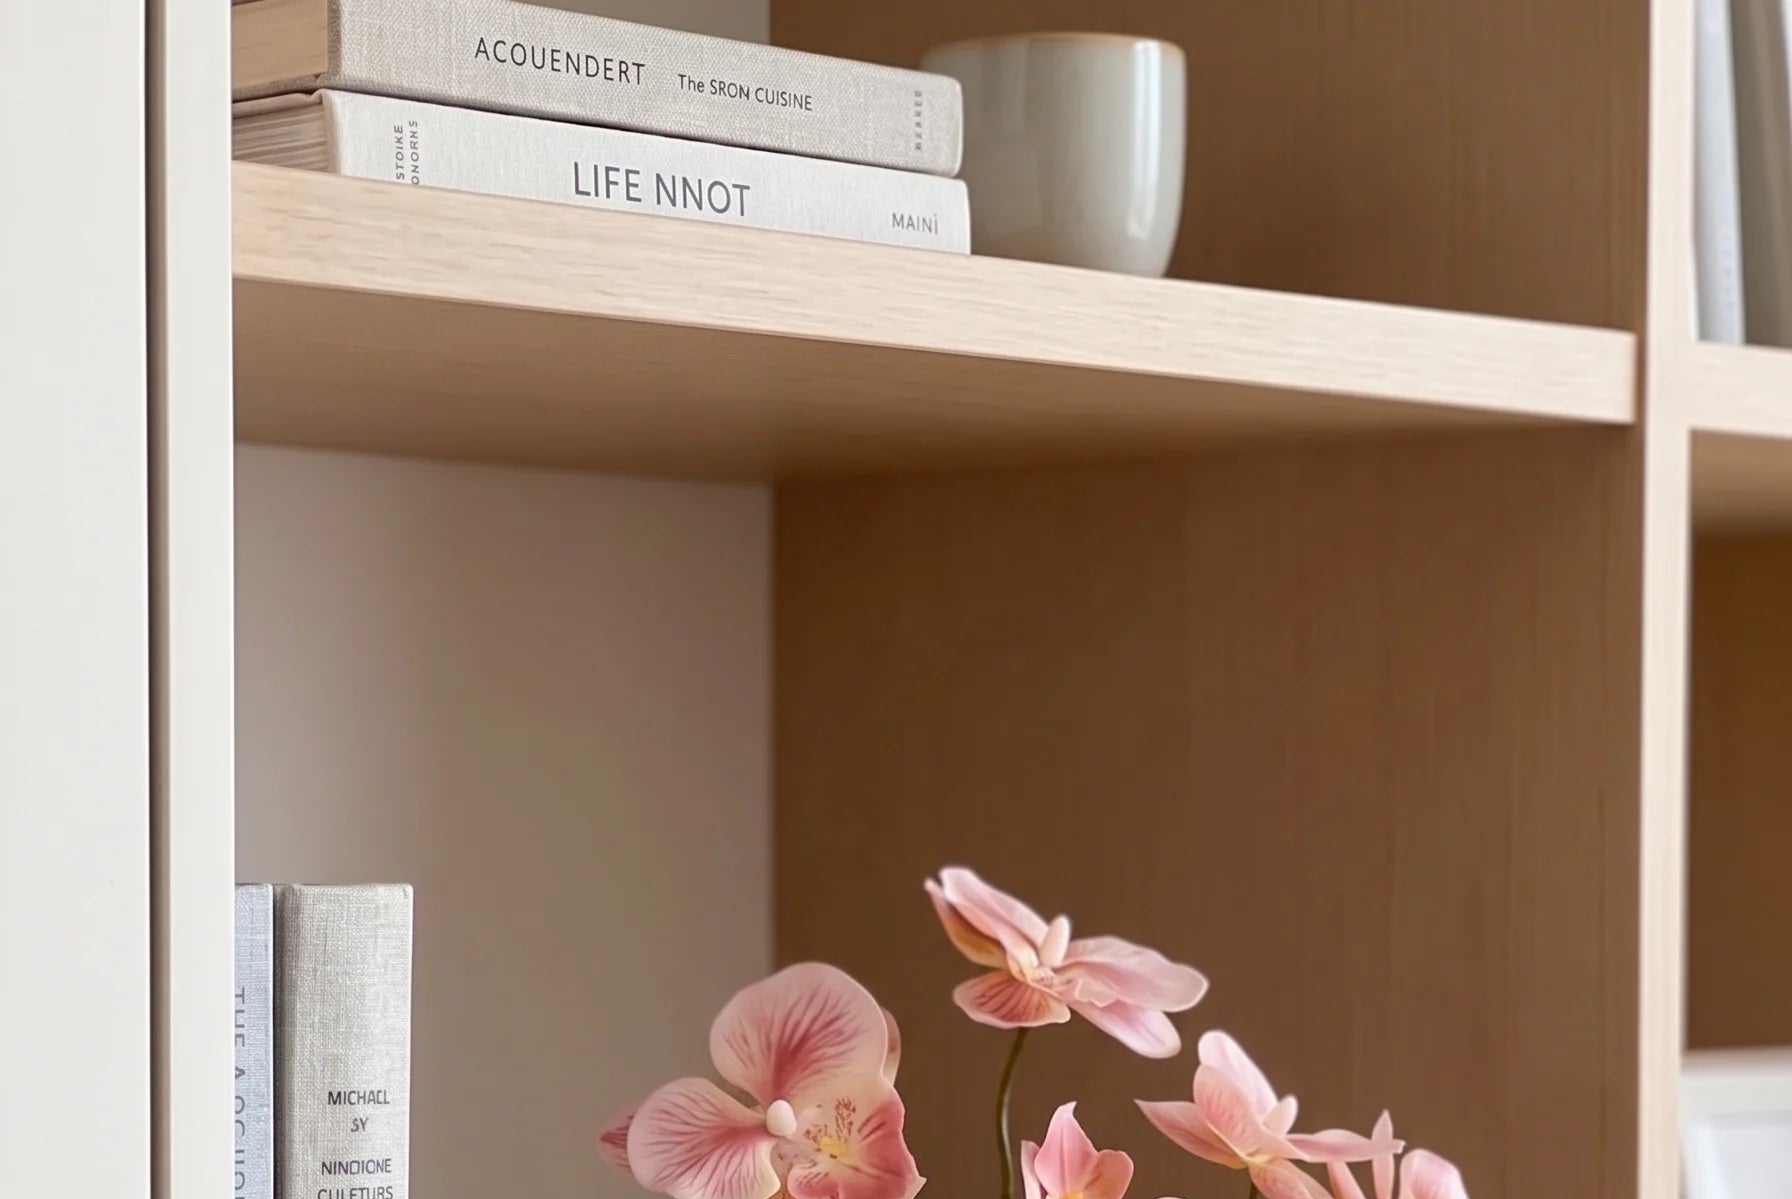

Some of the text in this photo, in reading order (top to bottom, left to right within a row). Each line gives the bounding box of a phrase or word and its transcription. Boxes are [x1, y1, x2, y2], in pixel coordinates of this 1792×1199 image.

[474, 37, 812, 111] ACOUENDERT The SRON CUISINE
[394, 125, 405, 180] STOIKE
[574, 161, 750, 216] LIFE NNOT
